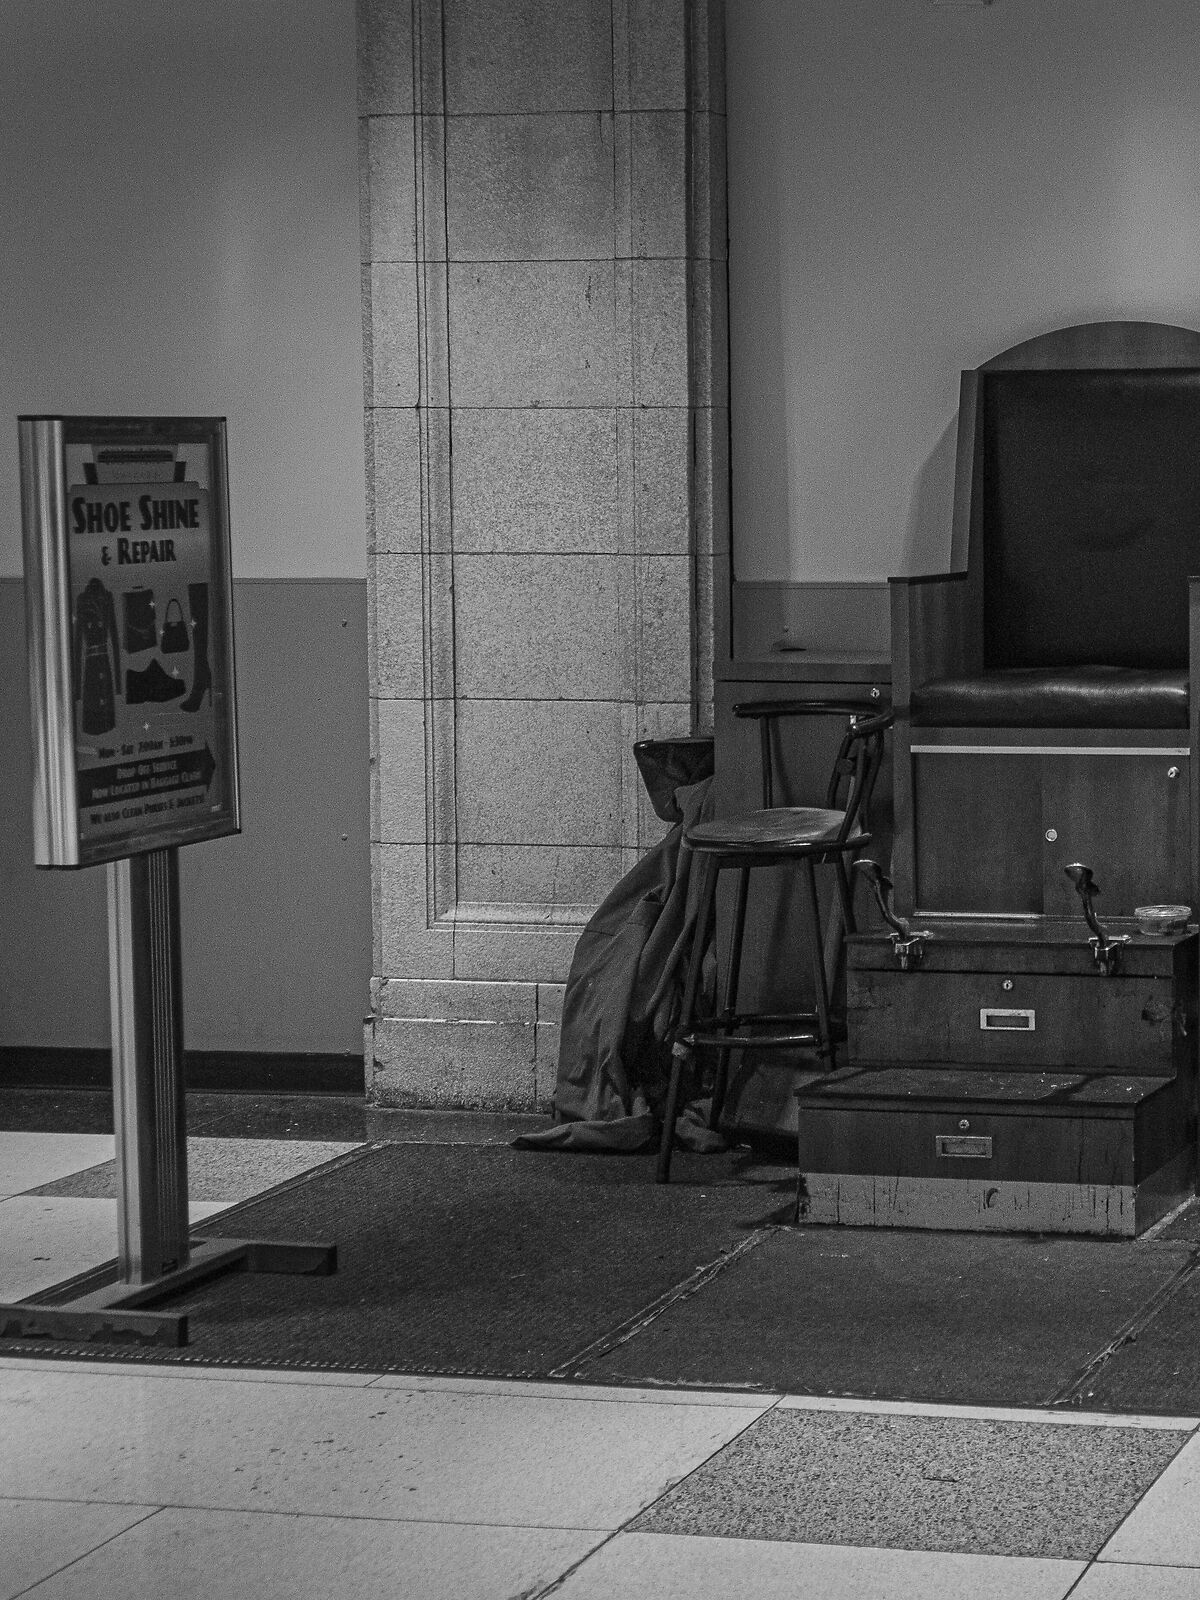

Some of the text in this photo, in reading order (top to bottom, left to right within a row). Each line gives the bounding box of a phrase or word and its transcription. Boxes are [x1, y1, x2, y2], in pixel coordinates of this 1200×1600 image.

[72, 495, 199, 534] SHOE SHINE
[101, 537, 177, 566] & REPAIR
